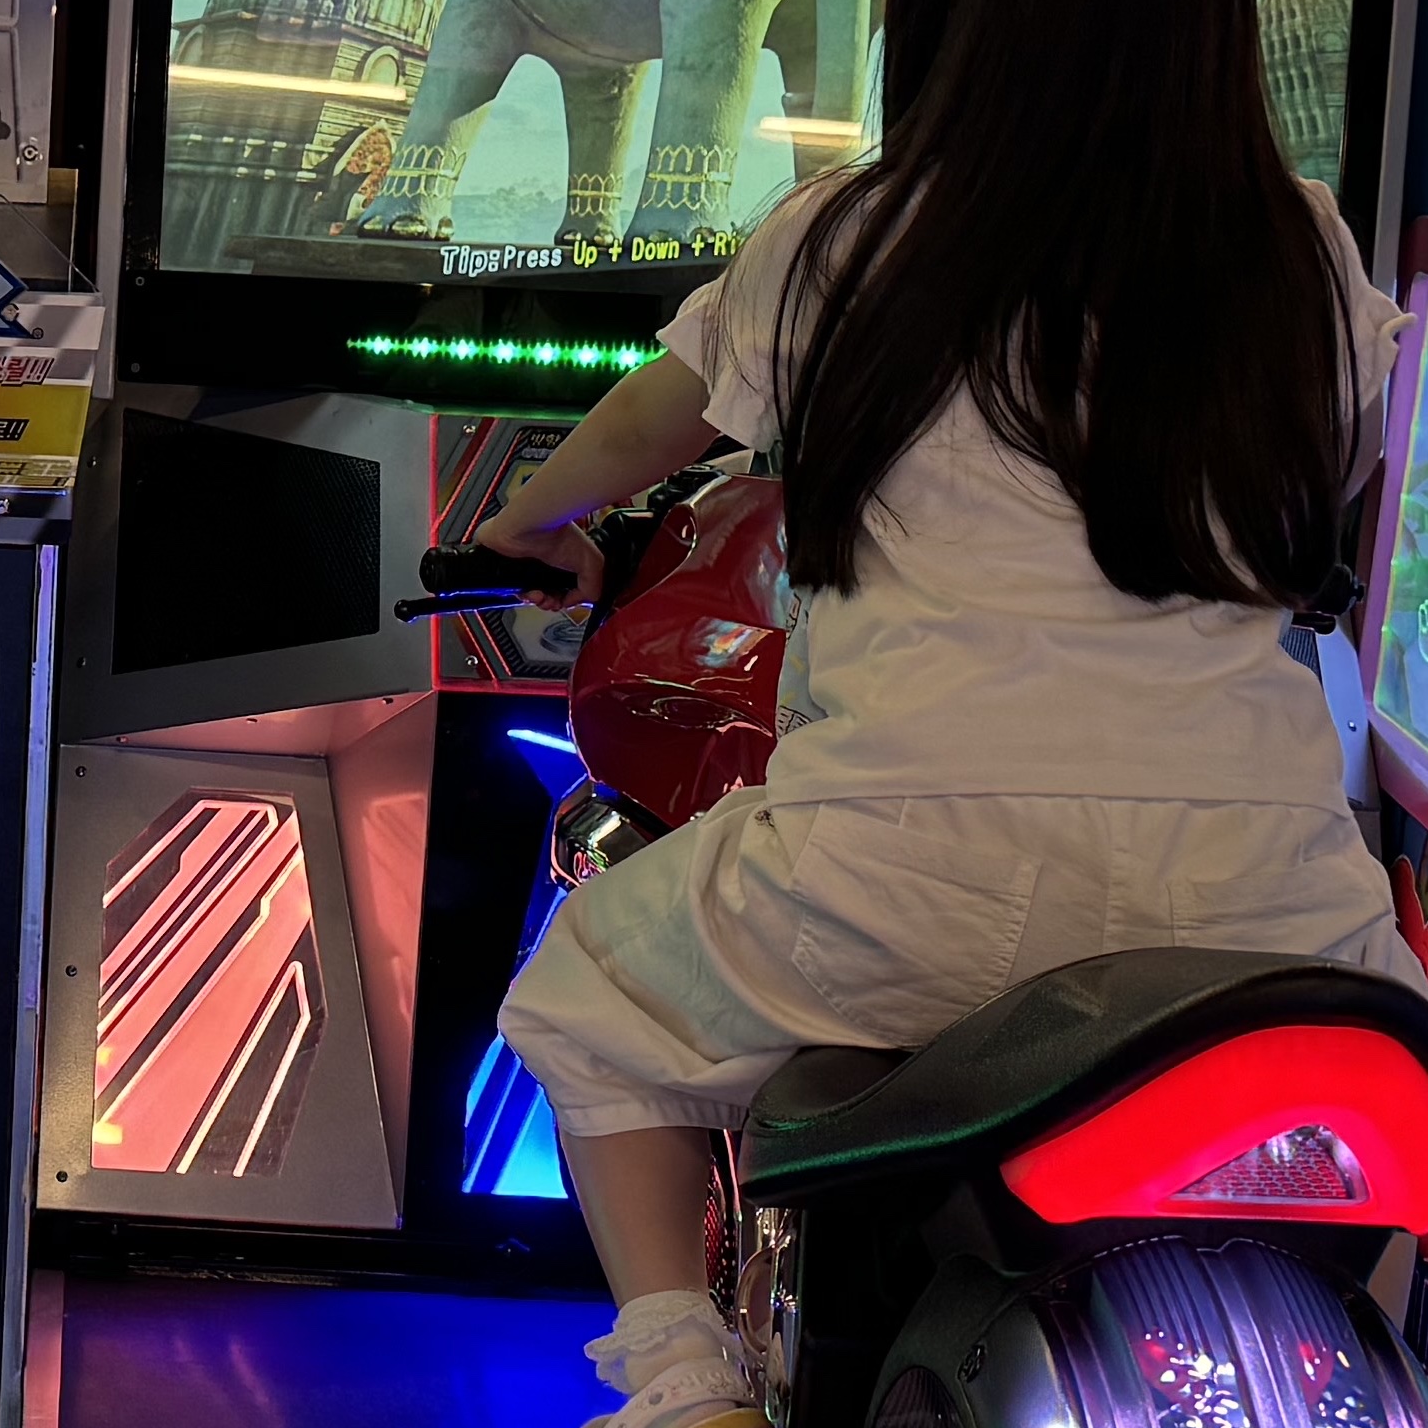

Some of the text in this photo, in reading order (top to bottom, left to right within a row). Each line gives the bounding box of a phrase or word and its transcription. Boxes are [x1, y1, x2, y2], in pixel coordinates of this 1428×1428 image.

[441, 245, 499, 277] Tip:
[503, 245, 563, 270] Press
[573, 240, 598, 268] Up
[609, 238, 623, 262] +
[631, 231, 680, 262] Down
[691, 234, 705, 257] +
